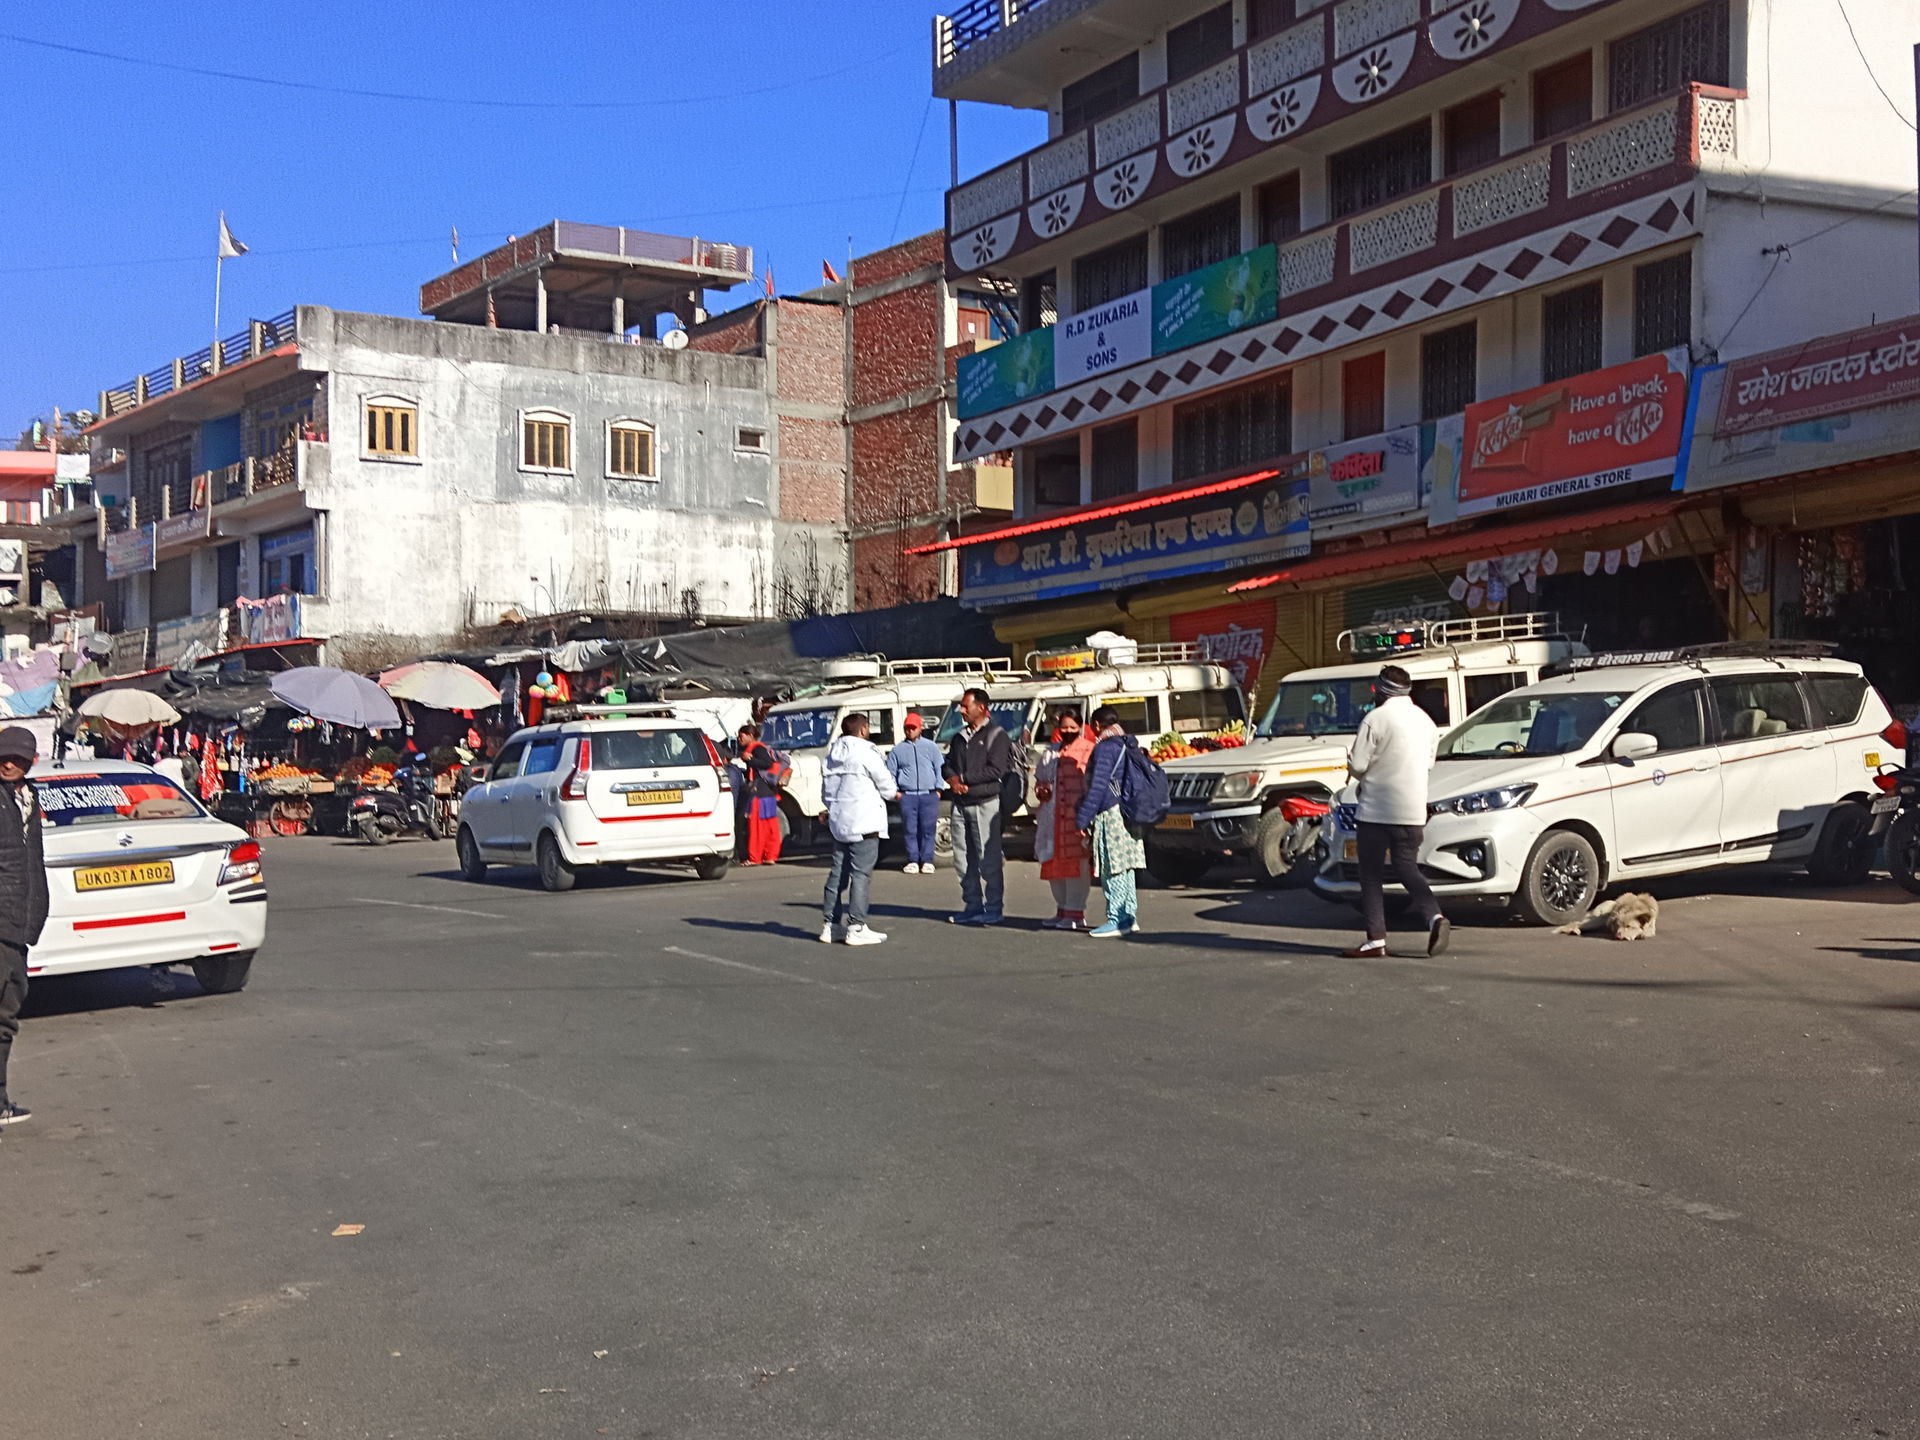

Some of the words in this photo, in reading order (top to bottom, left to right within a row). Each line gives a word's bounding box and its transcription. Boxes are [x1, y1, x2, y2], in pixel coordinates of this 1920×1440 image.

[1066, 319, 1084, 338] R.D
[1088, 300, 1138, 330] ZUKARIA
[1098, 331, 1105, 347] &
[1086, 347, 1117, 370] SONS
[1738, 365, 1790, 405] रमेश
[1791, 352, 1871, 391] जनरल
[1569, 397, 1605, 414] Have
[1608, 391, 1616, 404] a
[1568, 429, 1600, 445] have
[1604, 426, 1613, 437] a
[1615, 402, 1663, 445] KitKat
[1496, 489, 1537, 508] MURARI
[1540, 479, 1590, 499] GENERAL
[1594, 468, 1632, 487] STORE
[85, 866, 171, 885] UK03TA1802
